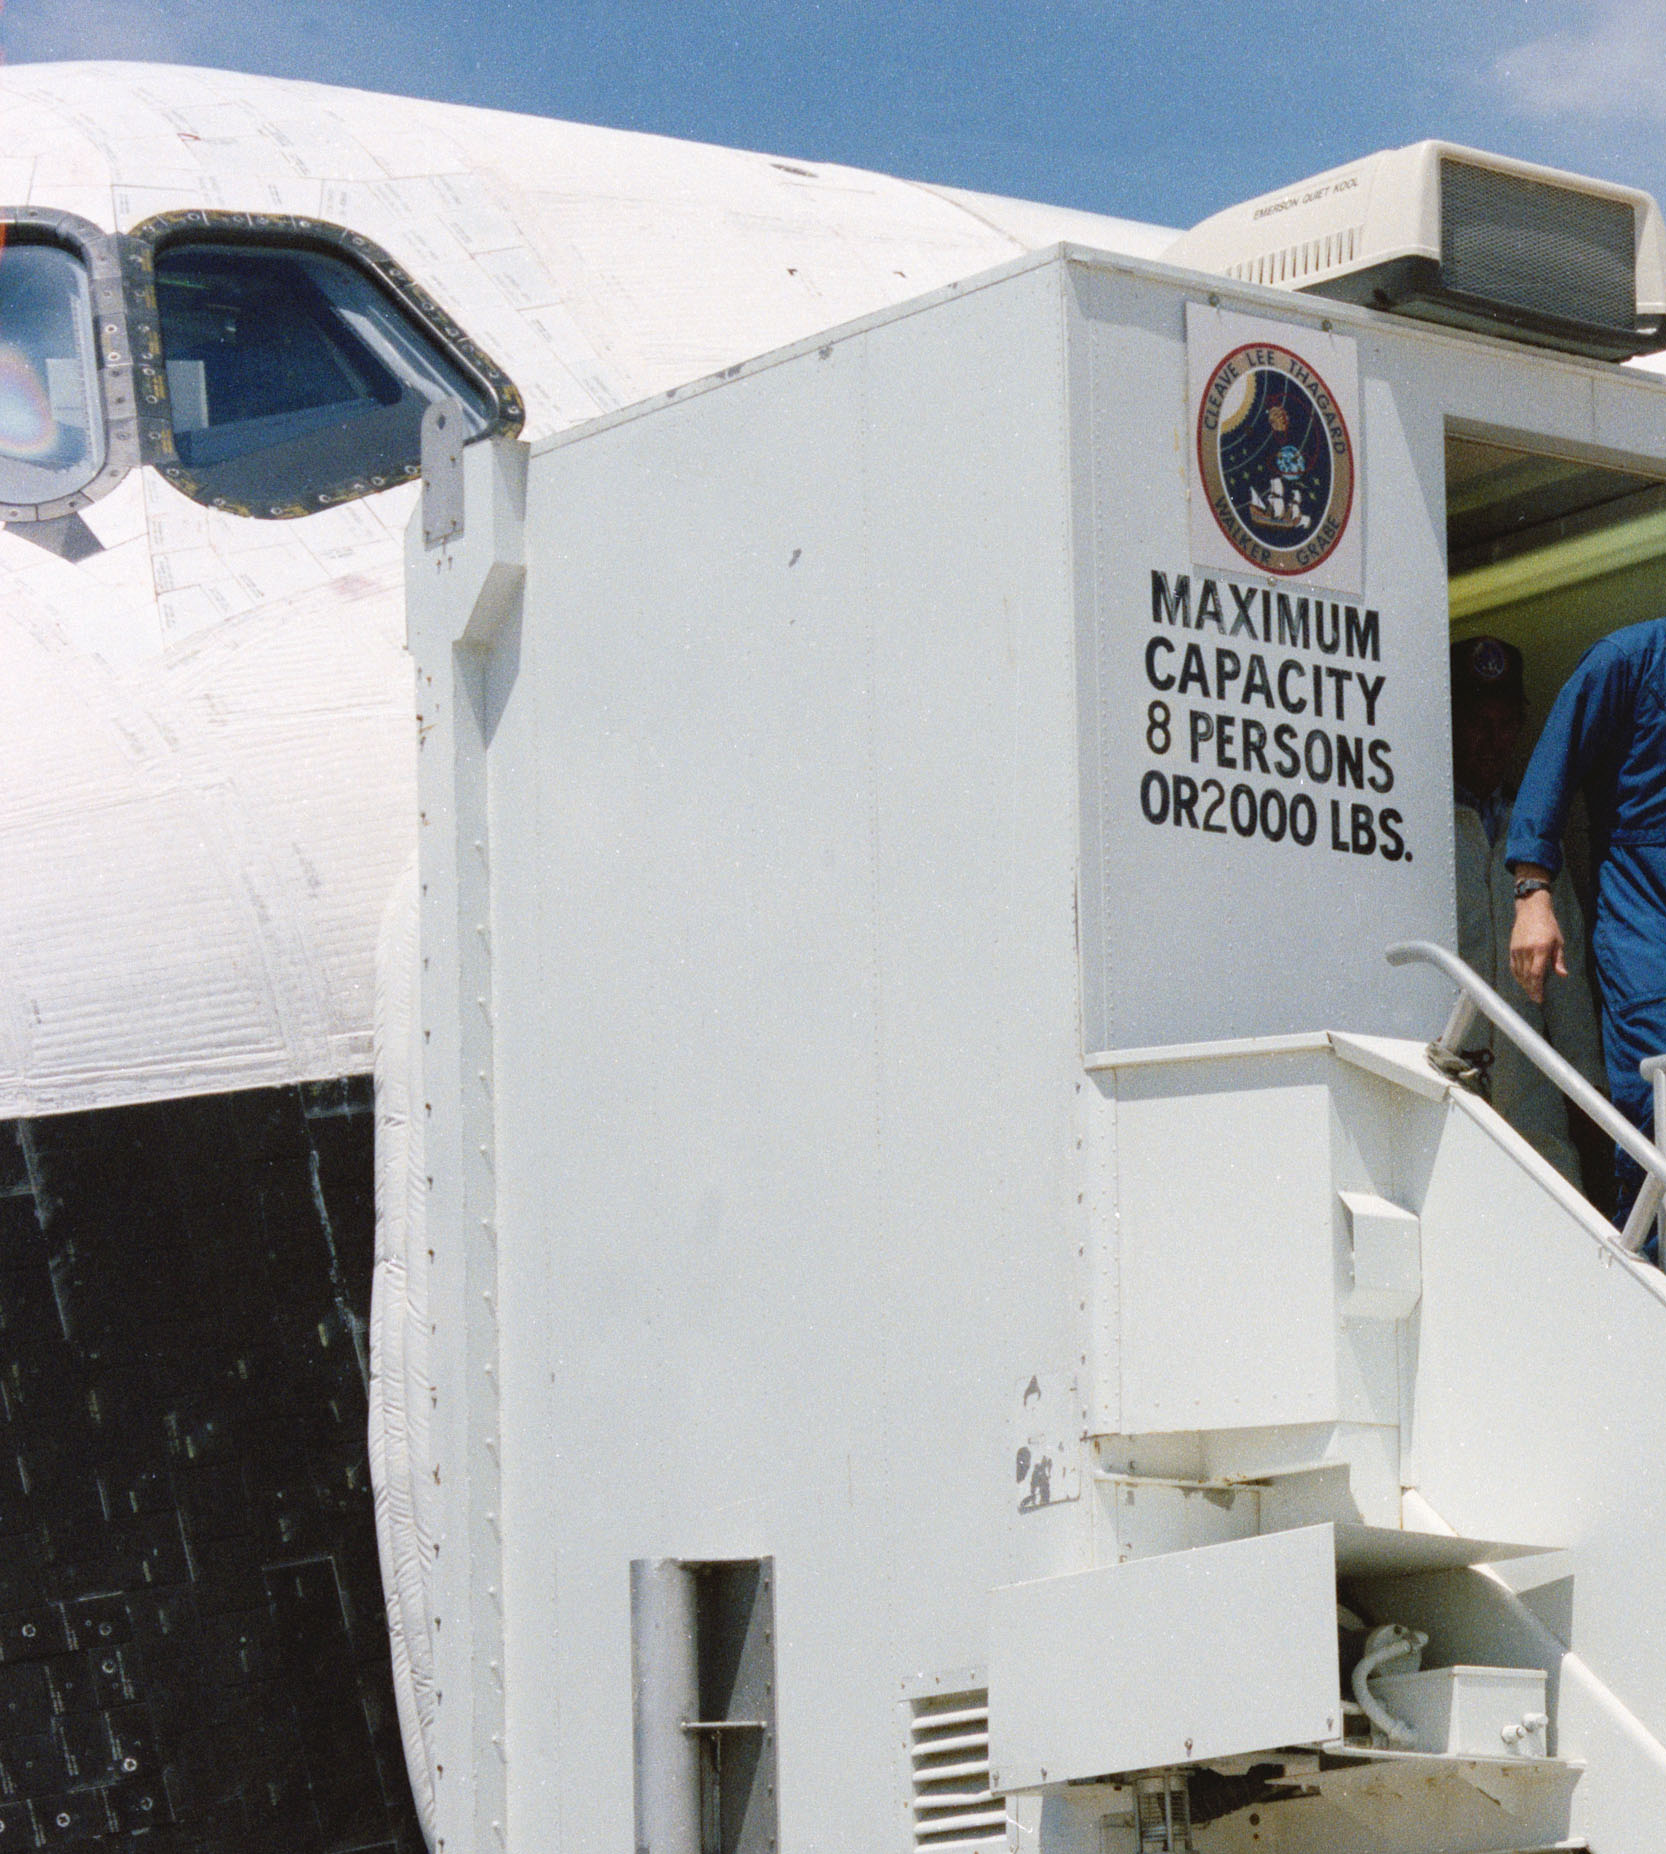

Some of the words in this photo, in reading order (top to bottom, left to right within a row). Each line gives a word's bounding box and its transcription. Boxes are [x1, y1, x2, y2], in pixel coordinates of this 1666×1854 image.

[1253, 198, 1299, 220] EMERSON
[1302, 186, 1330, 204] QUIET
[1333, 177, 1358, 194] KOOL
[1246, 351, 1276, 369] LEE
[1204, 363, 1240, 431] CLEAVE
[1289, 358, 1347, 455] THAGARD
[1213, 495, 1272, 565] WALKER
[1295, 516, 1340, 566] GRABE
[1151, 569, 1381, 662] MAXIMUM
[1145, 636, 1386, 727] CAPACITY
[1146, 701, 1172, 756] 8
[1189, 709, 1395, 794] PERSONS
[1331, 800, 1414, 864] LBS.
